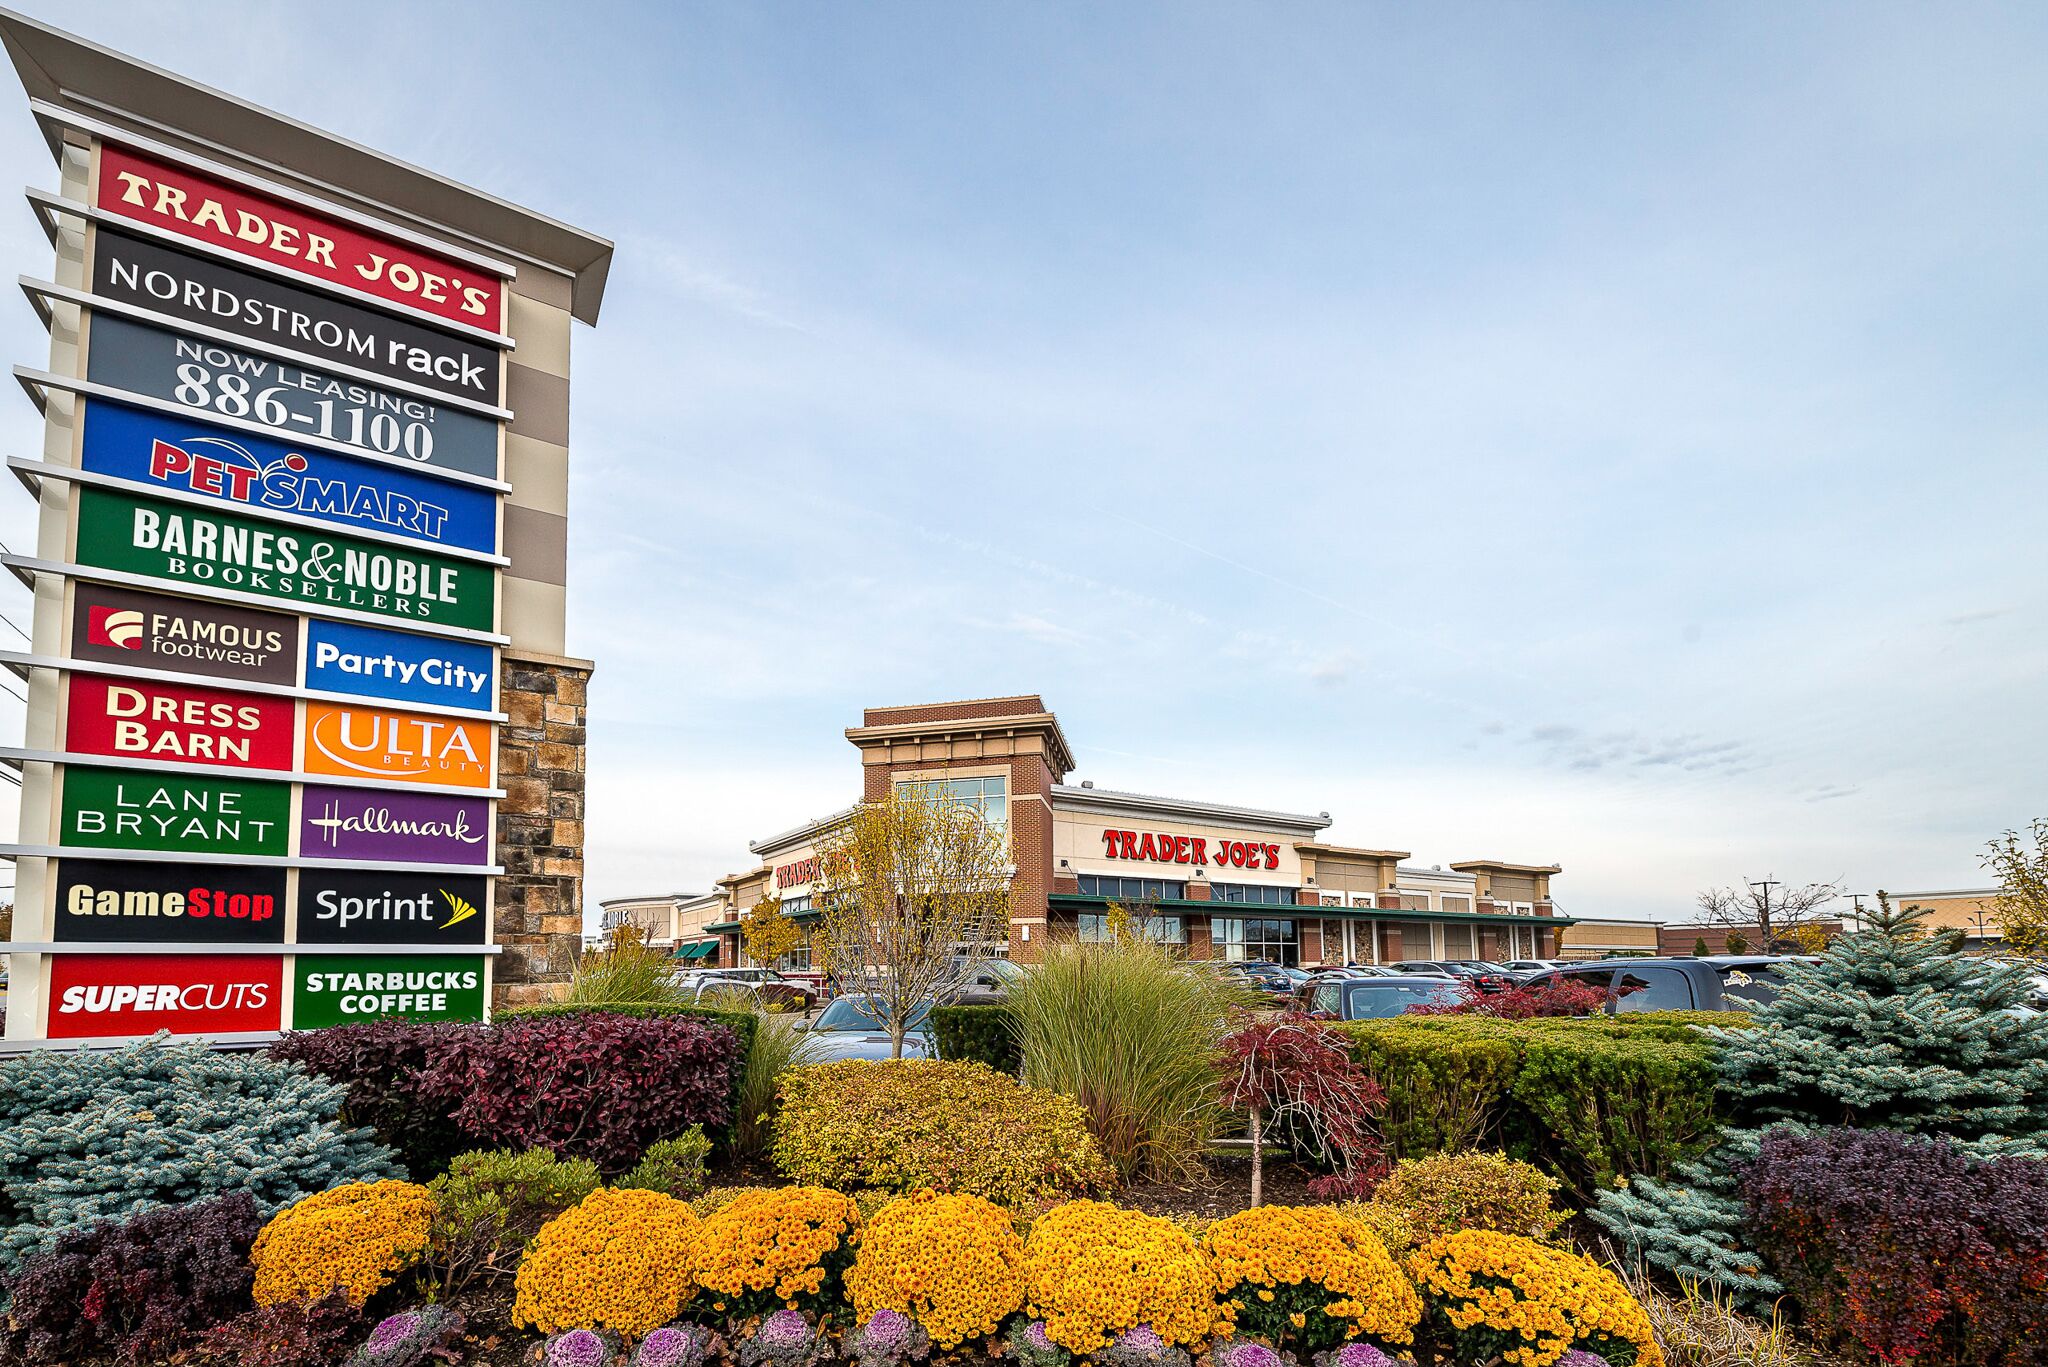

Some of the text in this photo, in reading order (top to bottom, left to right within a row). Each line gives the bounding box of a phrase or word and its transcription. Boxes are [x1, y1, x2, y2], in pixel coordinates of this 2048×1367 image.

[117, 171, 491, 317] TRADER JOE'S
[110, 258, 486, 391] NORDSTROM rack
[175, 339, 436, 423] NOW LEASING!
[174, 362, 434, 462] 886-1100
[167, 557, 431, 617] BOOKSELLERS
[152, 613, 282, 652] FAMOUS
[152, 636, 268, 667] footwear
[106, 685, 261, 731] DRESS
[114, 720, 251, 762] BARN
[340, 711, 479, 763] ULTA
[383, 755, 485, 773] BEAUTY
[116, 784, 242, 815] LANE
[76, 810, 275, 843] BRYANT
[308, 799, 485, 848] Hallmark
[1102, 829, 1281, 869] TRADER JOE'S
[67, 884, 274, 921] GameStop
[316, 889, 434, 928] Sprint
[58, 983, 270, 1014] SUPERCUTS
[306, 971, 478, 992] STARBUCKS
[339, 993, 447, 1014] COFFEE
